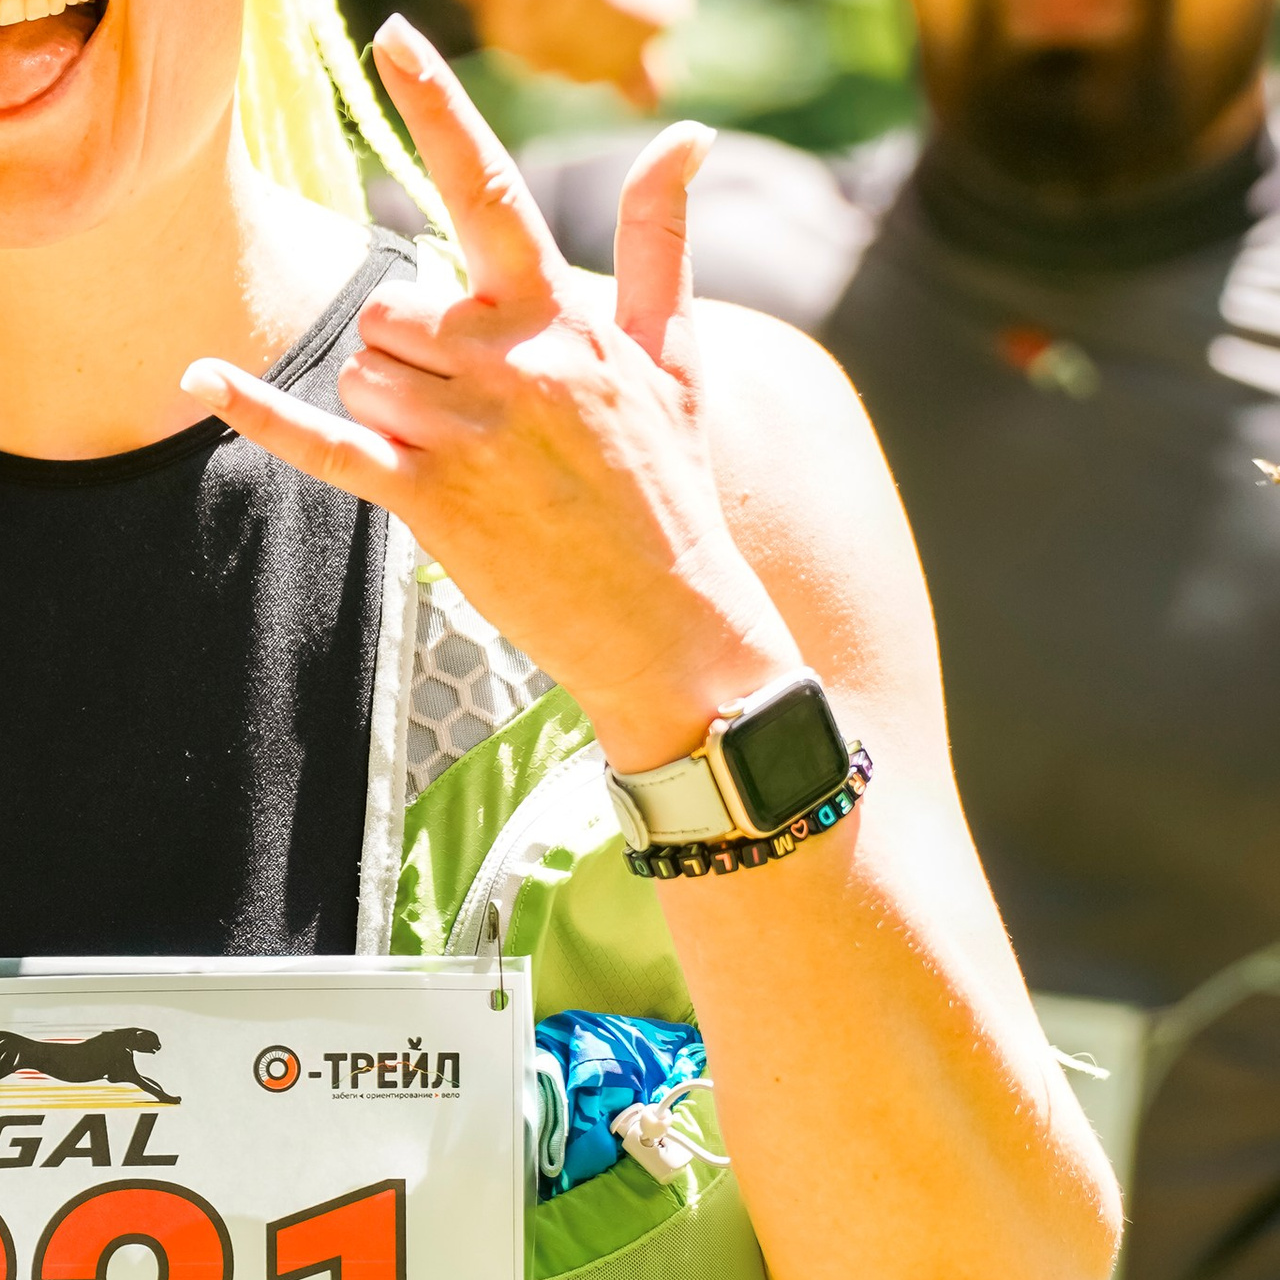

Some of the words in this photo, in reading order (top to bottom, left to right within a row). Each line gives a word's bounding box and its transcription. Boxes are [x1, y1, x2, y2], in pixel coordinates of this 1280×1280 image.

[331, 1092, 358, 1100] забеги
[365, 1092, 434, 1101] ориентирование
[440, 1092, 461, 1100] вело
